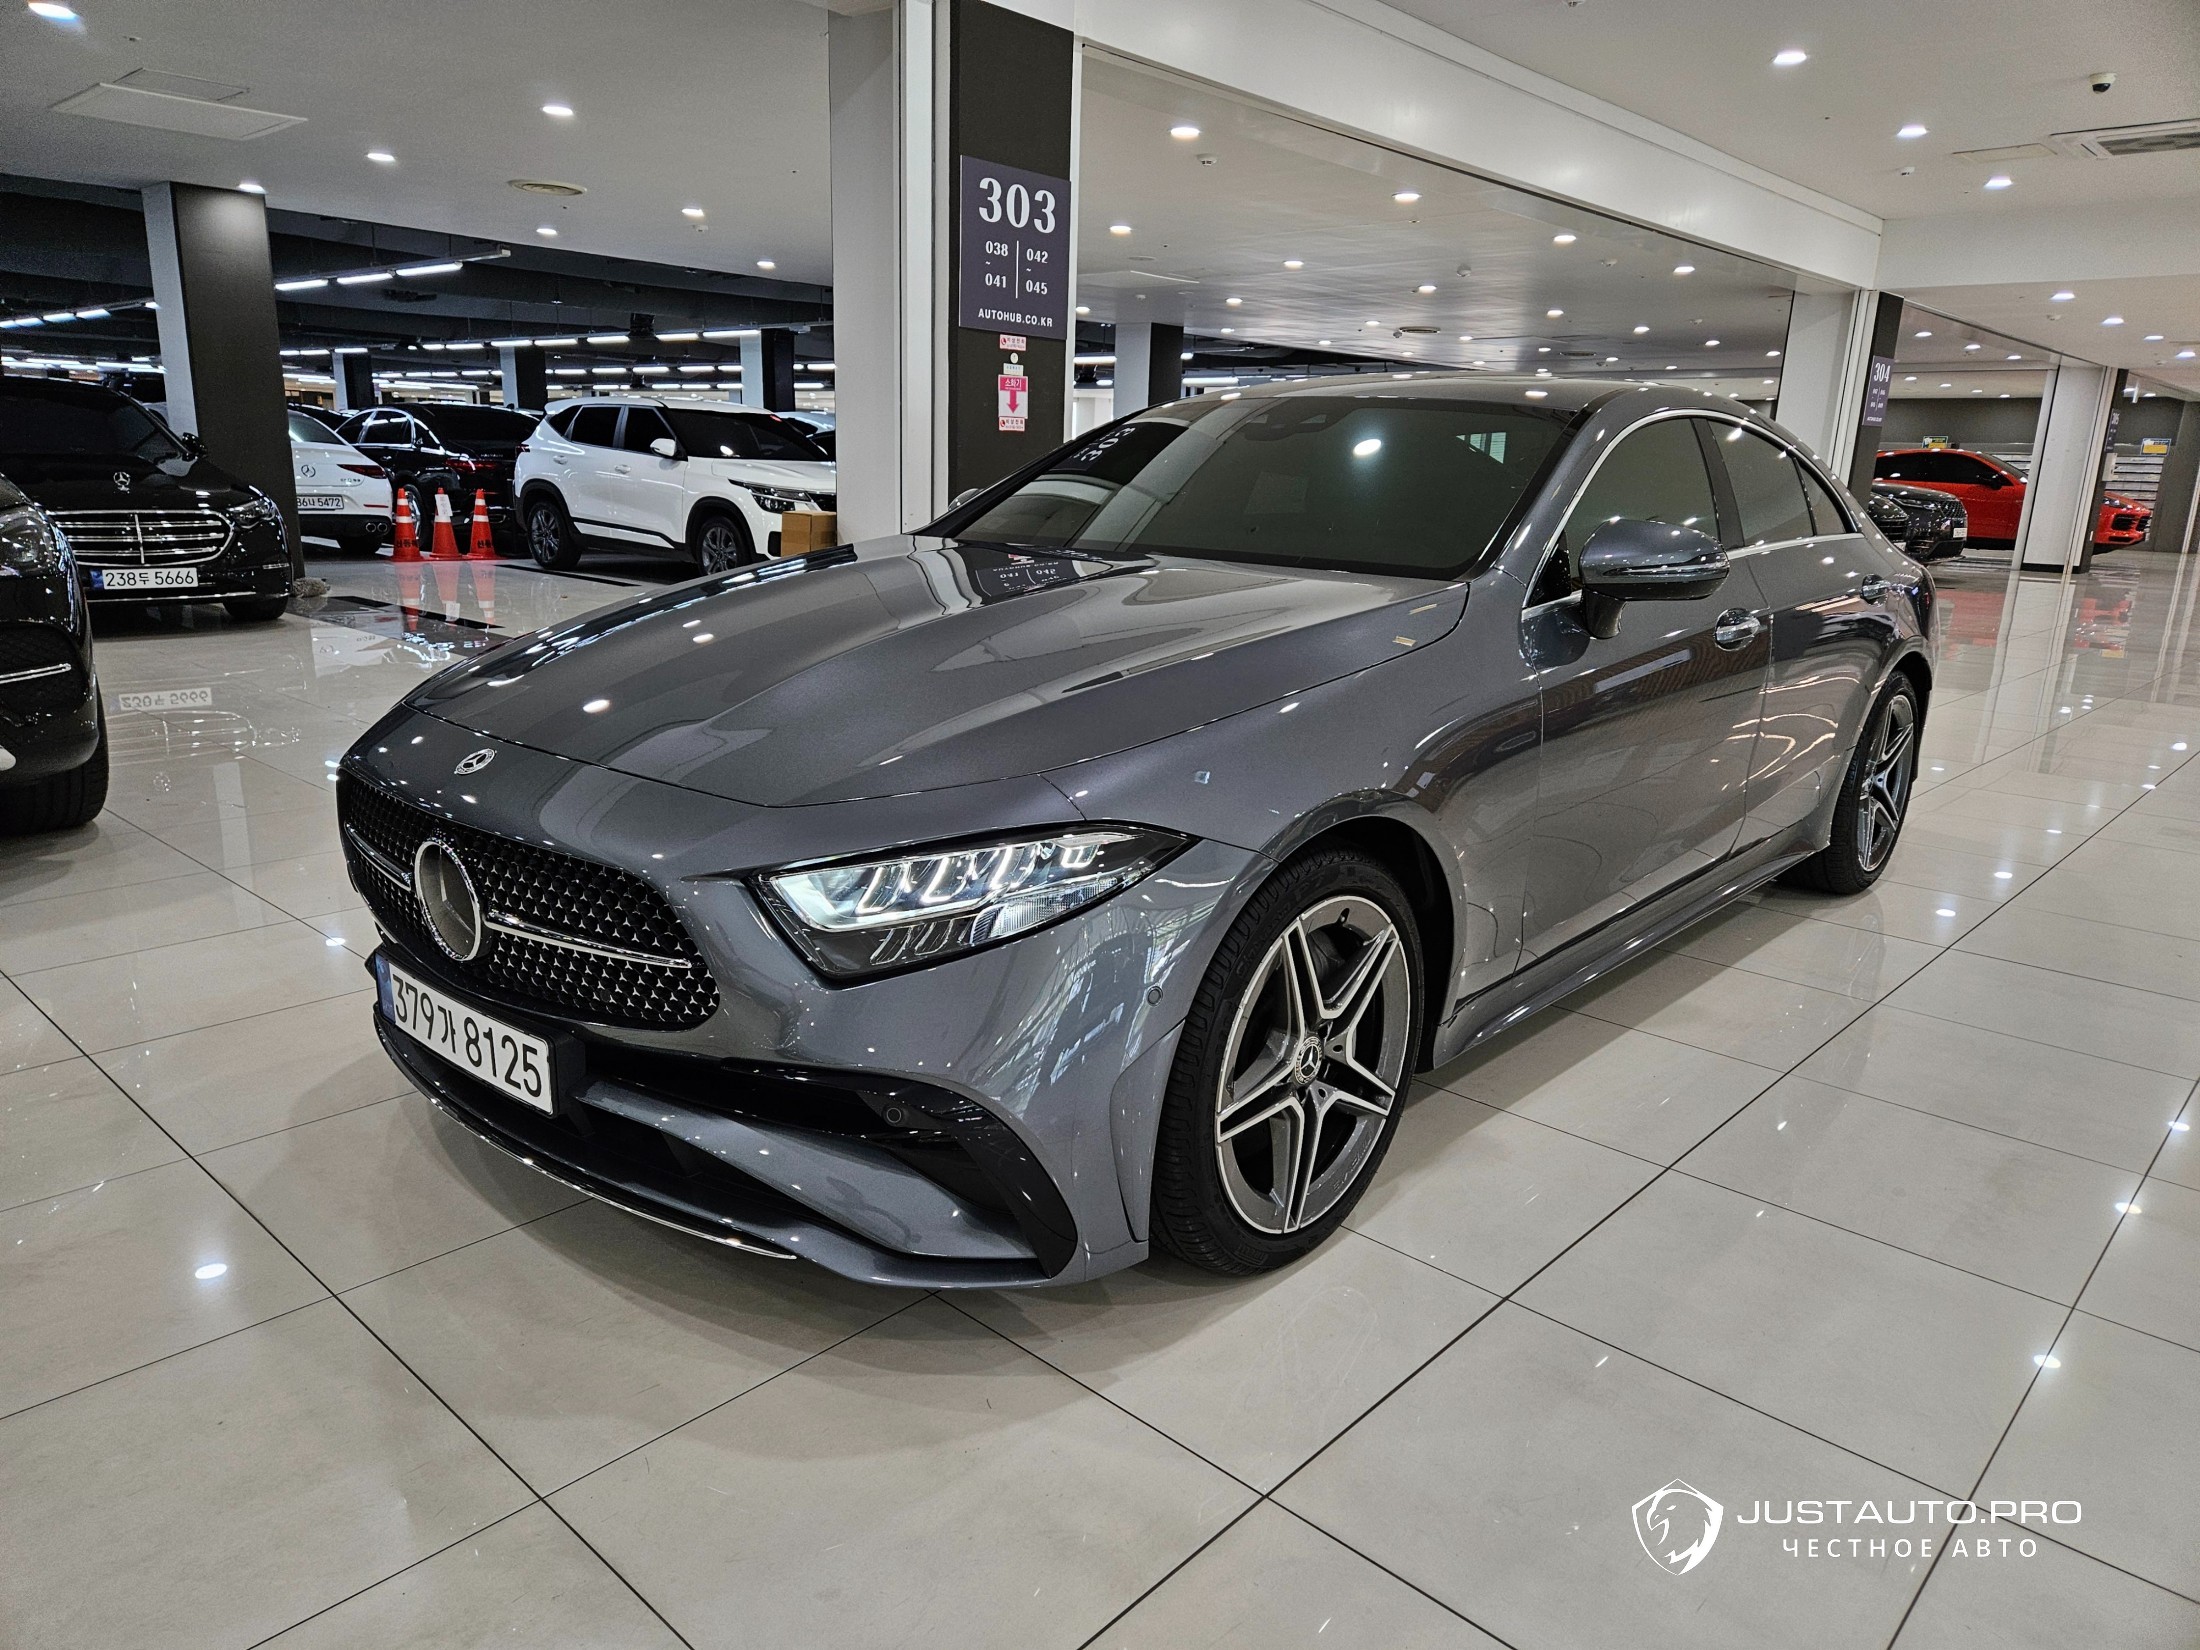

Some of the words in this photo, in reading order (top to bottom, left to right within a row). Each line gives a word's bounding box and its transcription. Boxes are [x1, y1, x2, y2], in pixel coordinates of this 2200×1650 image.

[979, 177, 1056, 233] 303
[985, 240, 1009, 257] 038
[1026, 248, 1048, 263] 042
[985, 273, 1007, 289] 041
[1026, 279, 1048, 295] 045
[978, 308, 1053, 328] AUTOHUB.CO.KR
[1873, 362, 1891, 382] 304
[1005, 378, 1022, 388] 소화기
[317, 497, 341, 507] 5472
[105, 572, 149, 587] 238두
[155, 571, 194, 585] 5666
[392, 973, 456, 1054] 379가
[464, 1017, 542, 1098] 8125
